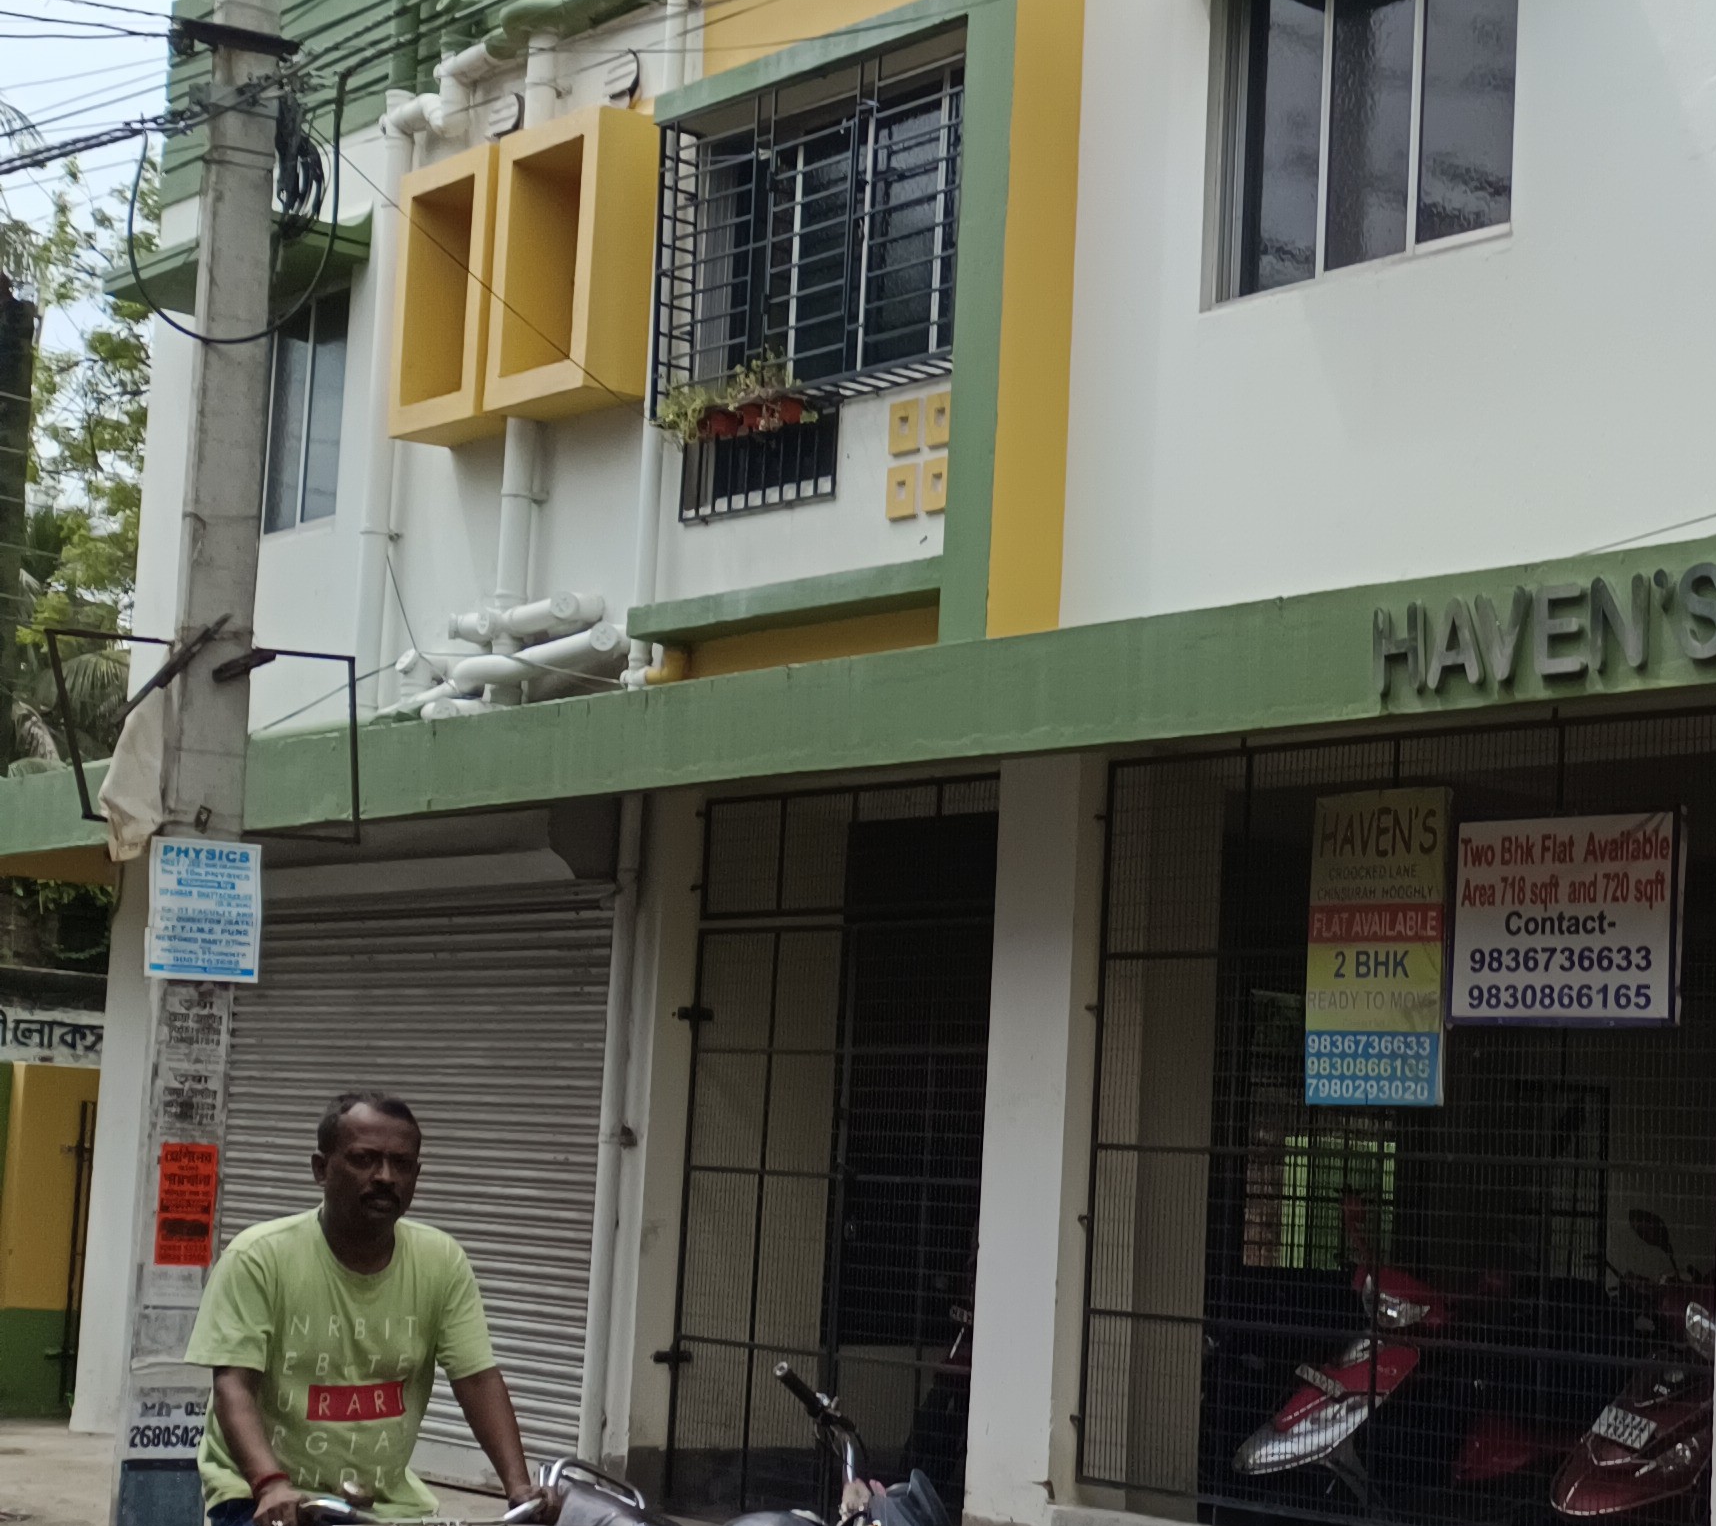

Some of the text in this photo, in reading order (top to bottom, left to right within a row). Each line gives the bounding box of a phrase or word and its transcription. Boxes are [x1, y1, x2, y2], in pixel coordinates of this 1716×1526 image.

[1319, 805, 1438, 858] HAVEN'S
[162, 844, 251, 863] PHYSICS
[1460, 828, 1670, 868] Two Bhk Flat Available
[1460, 869, 1666, 912] Area 718 sqft and 720 sqft
[1313, 911, 1437, 937] FLAT AVAILABLE
[1504, 910, 1617, 936] Contact-
[1333, 949, 1410, 979] 2 BHK
[1469, 945, 1652, 973] 9836736633
[1307, 990, 1359, 1011] READY
[1363, 990, 1385, 1010] TO
[1467, 982, 1652, 1010] 9830866165
[1307, 1034, 1431, 1056] 9836736633
[1307, 1056, 1430, 1079] 9830866165
[1306, 1078, 1429, 1100] 7980293020
